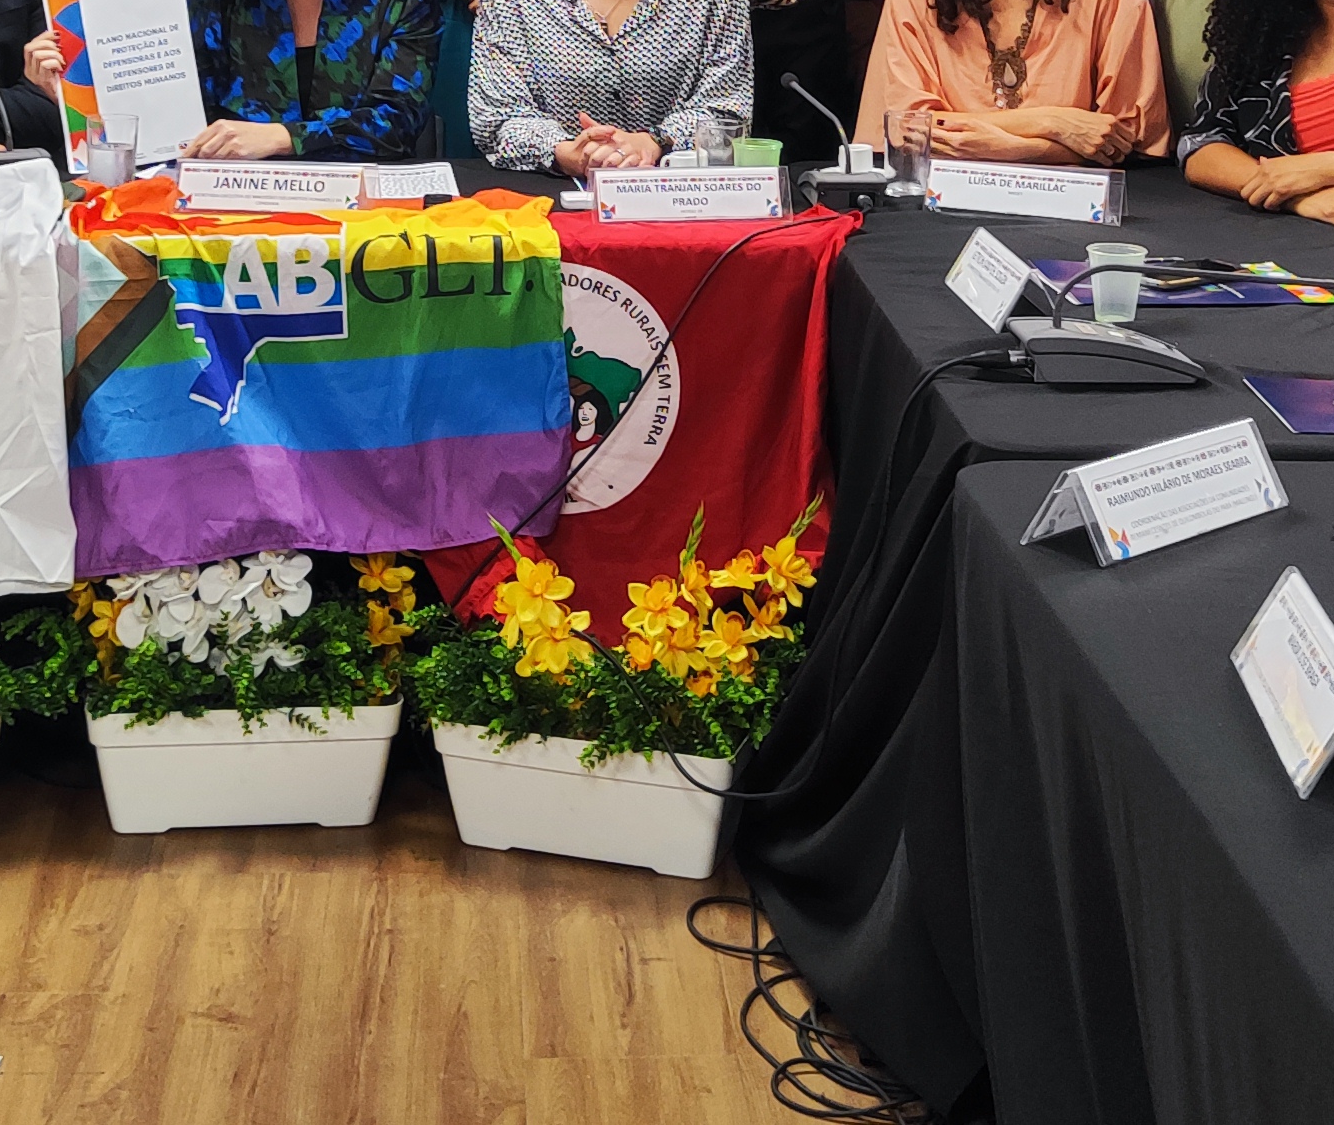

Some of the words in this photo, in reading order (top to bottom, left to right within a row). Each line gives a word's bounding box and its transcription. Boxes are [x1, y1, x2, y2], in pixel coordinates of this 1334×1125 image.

[96, 34, 124, 46] PLANO
[125, 26, 168, 41] NACIONAL
[168, 23, 179, 33] DE
[111, 39, 156, 55] PROTEÇÃO
[103, 52, 156, 69] DEFENSORAS
[163, 48, 182, 58] AOS
[112, 63, 164, 80] DEFENSORES
[165, 61, 175, 70] DE
[106, 79, 143, 93] DIREITOS
[144, 71, 187, 85] HUMANOS
[213, 176, 269, 191] JANINE
[272, 178, 326, 194] MELLO
[616, 184, 652, 194] MARIA
[654, 183, 702, 193] TRANJAN
[703, 182, 744, 193] SOARES
[745, 182, 762, 192] DO
[968, 174, 998, 187] LUÍSA
[998, 178, 1013, 189] DE
[1014, 180, 1068, 194] MARILLAC
[671, 196, 710, 207] PRADO
[619, 297, 666, 353] RURAIS
[642, 394, 672, 447] TERRA
[1106, 484, 1152, 508] RAIMUNDO
[1151, 477, 1183, 496] HILÁRIO
[1181, 473, 1193, 486] DE
[1191, 465, 1224, 483] MORAES
